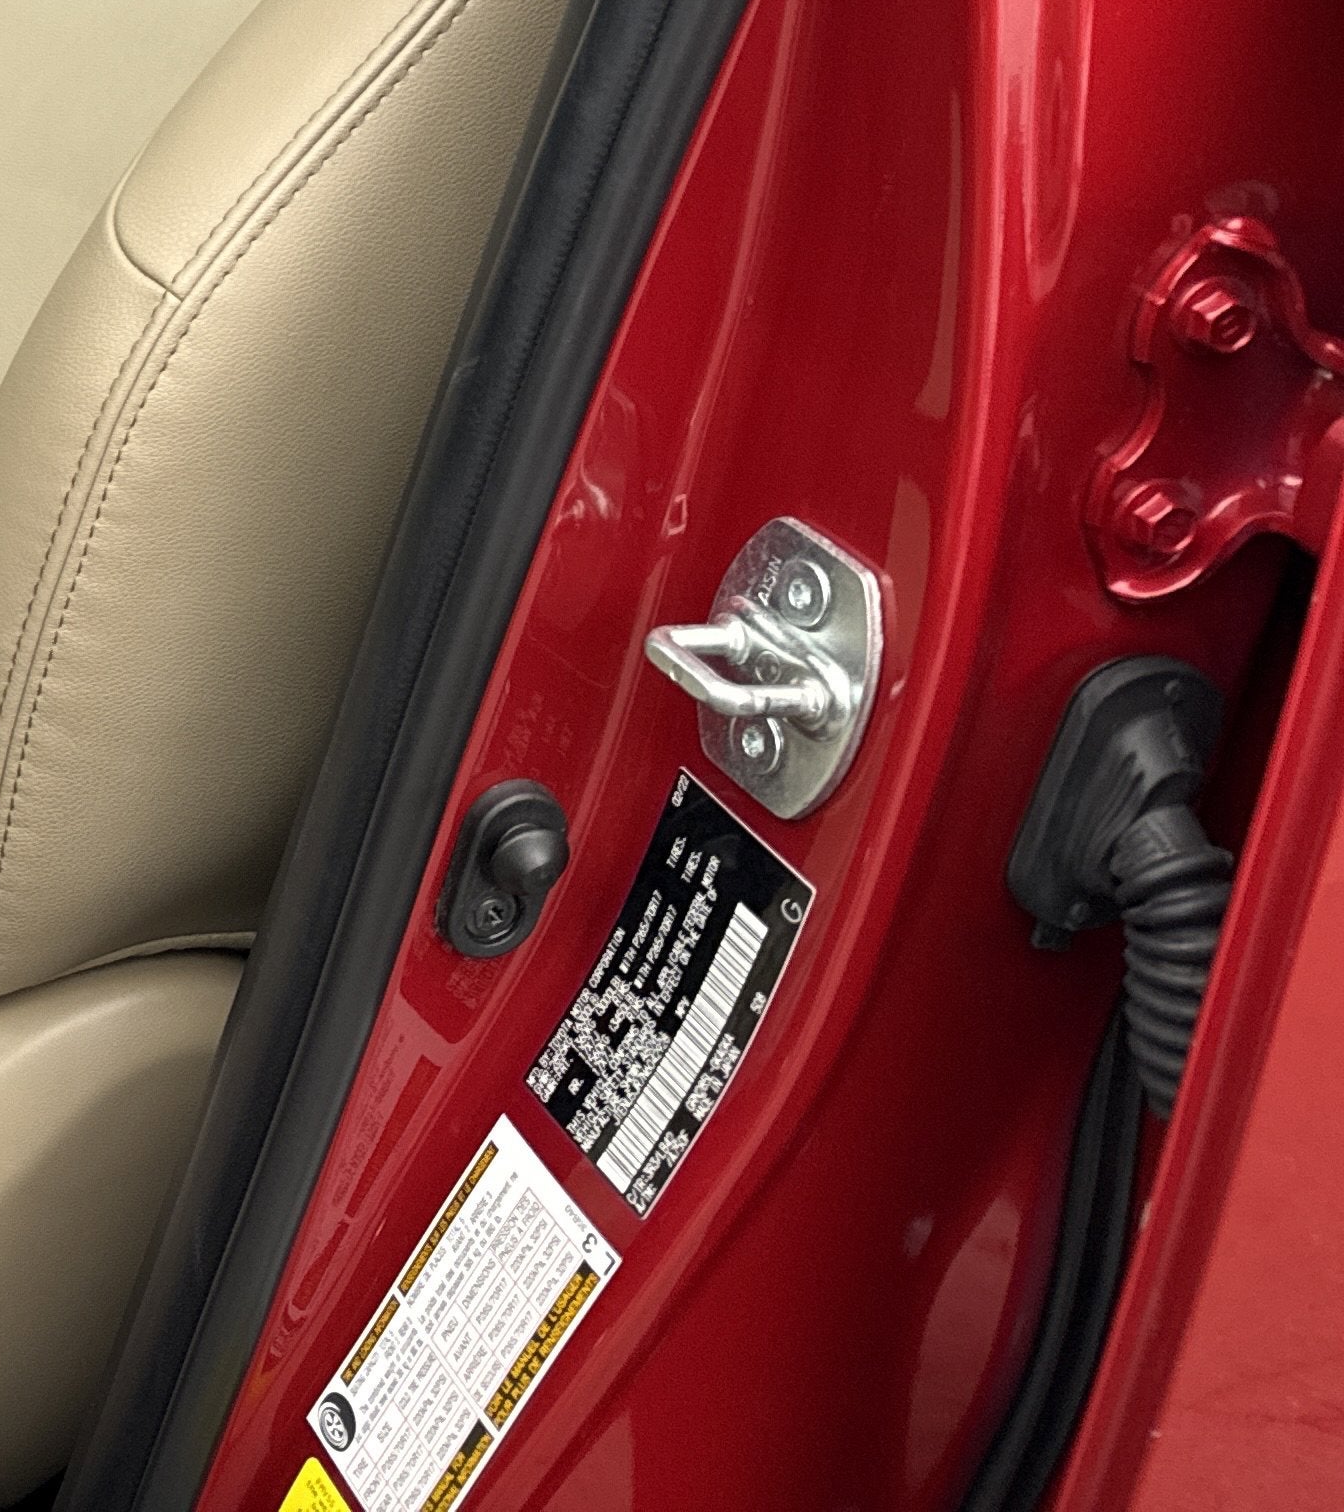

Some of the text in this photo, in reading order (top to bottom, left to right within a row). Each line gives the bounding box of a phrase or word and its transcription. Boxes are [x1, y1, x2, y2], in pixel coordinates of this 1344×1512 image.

[757, 554, 781, 607] AISIN
[672, 774, 689, 807] 02/22
[700, 855, 721, 888] MOTOR
[631, 888, 663, 949] P265/70R17
[666, 837, 687, 868] TIRES.
[645, 903, 678, 965] P265/70R17
[681, 851, 703, 883] TIRES.
[706, 884, 718, 903] OF
[781, 898, 802, 923] G
[569, 985, 592, 1019] MOTOR
[587, 925, 626, 989] CORPORATION
[582, 1233, 598, 1254] 3
[462, 1258, 495, 1309] DIMENSIONS
[452, 1332, 471, 1361] AVANT
[501, 1377, 512, 1393] LE
[510, 1336, 538, 1379] MANUEL
[537, 1321, 549, 1338] DE
